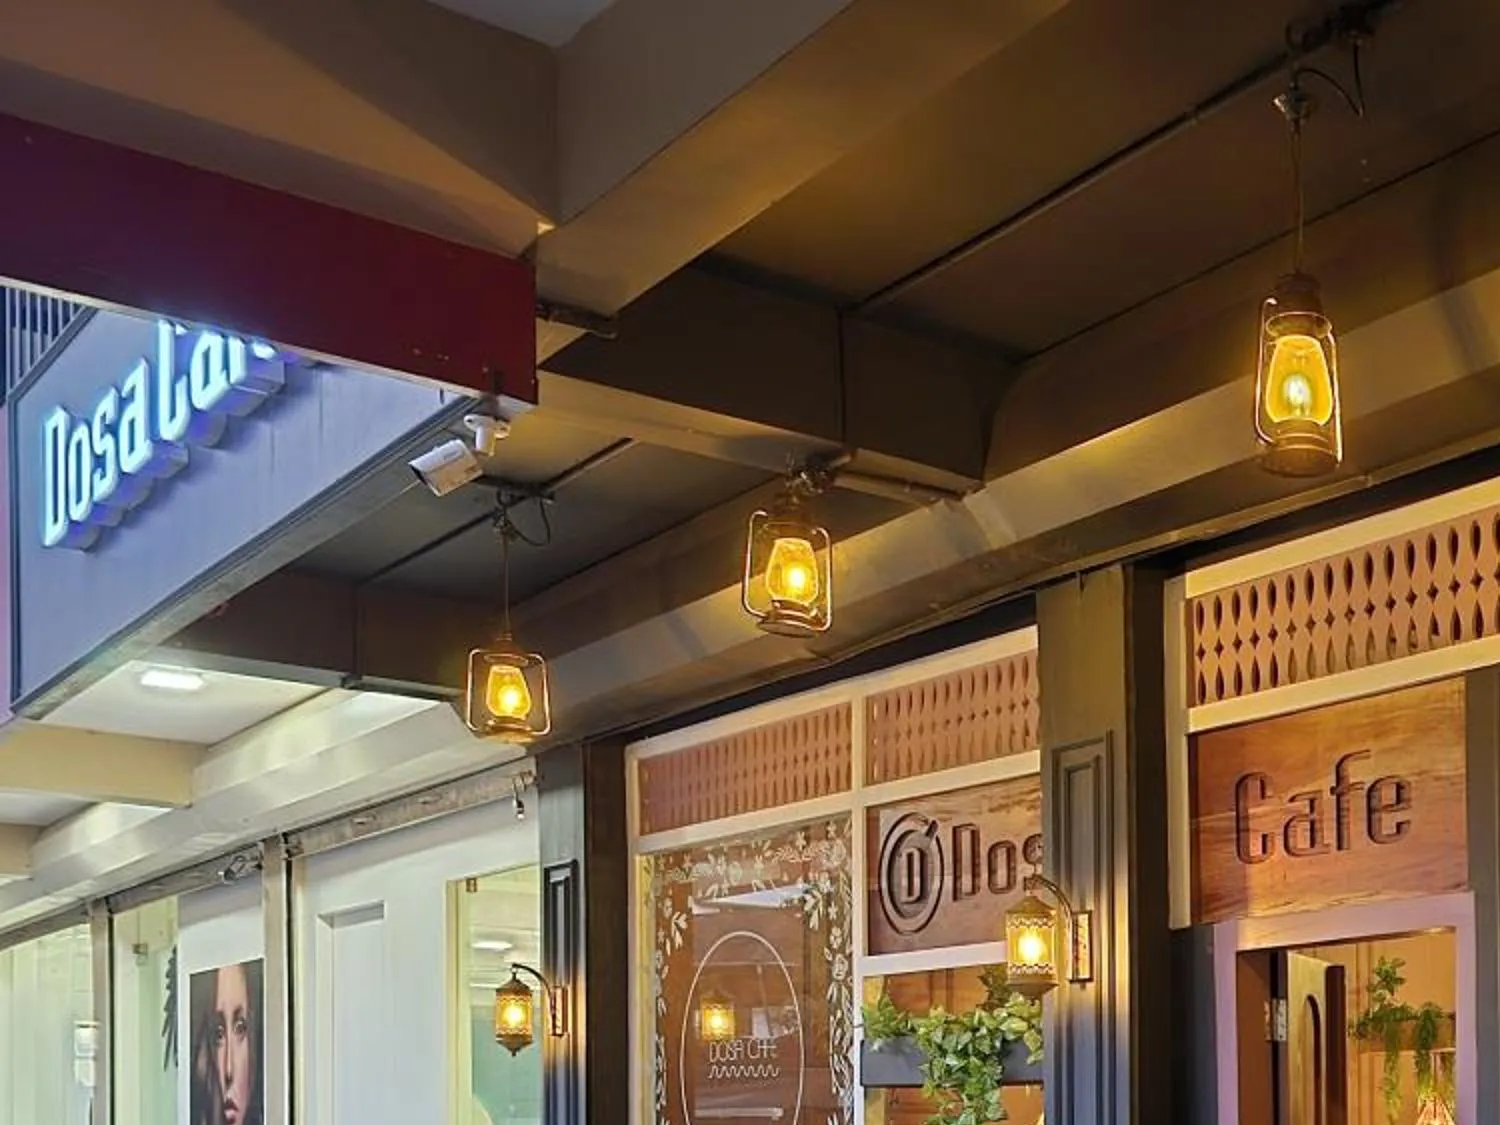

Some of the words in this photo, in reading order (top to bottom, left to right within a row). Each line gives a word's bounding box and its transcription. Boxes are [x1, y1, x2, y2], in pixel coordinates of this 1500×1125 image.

[43, 356, 152, 547] Dosa
[157, 318, 277, 442] Ca
[952, 823, 1044, 902] Dos
[1235, 748, 1412, 864] Cafe
